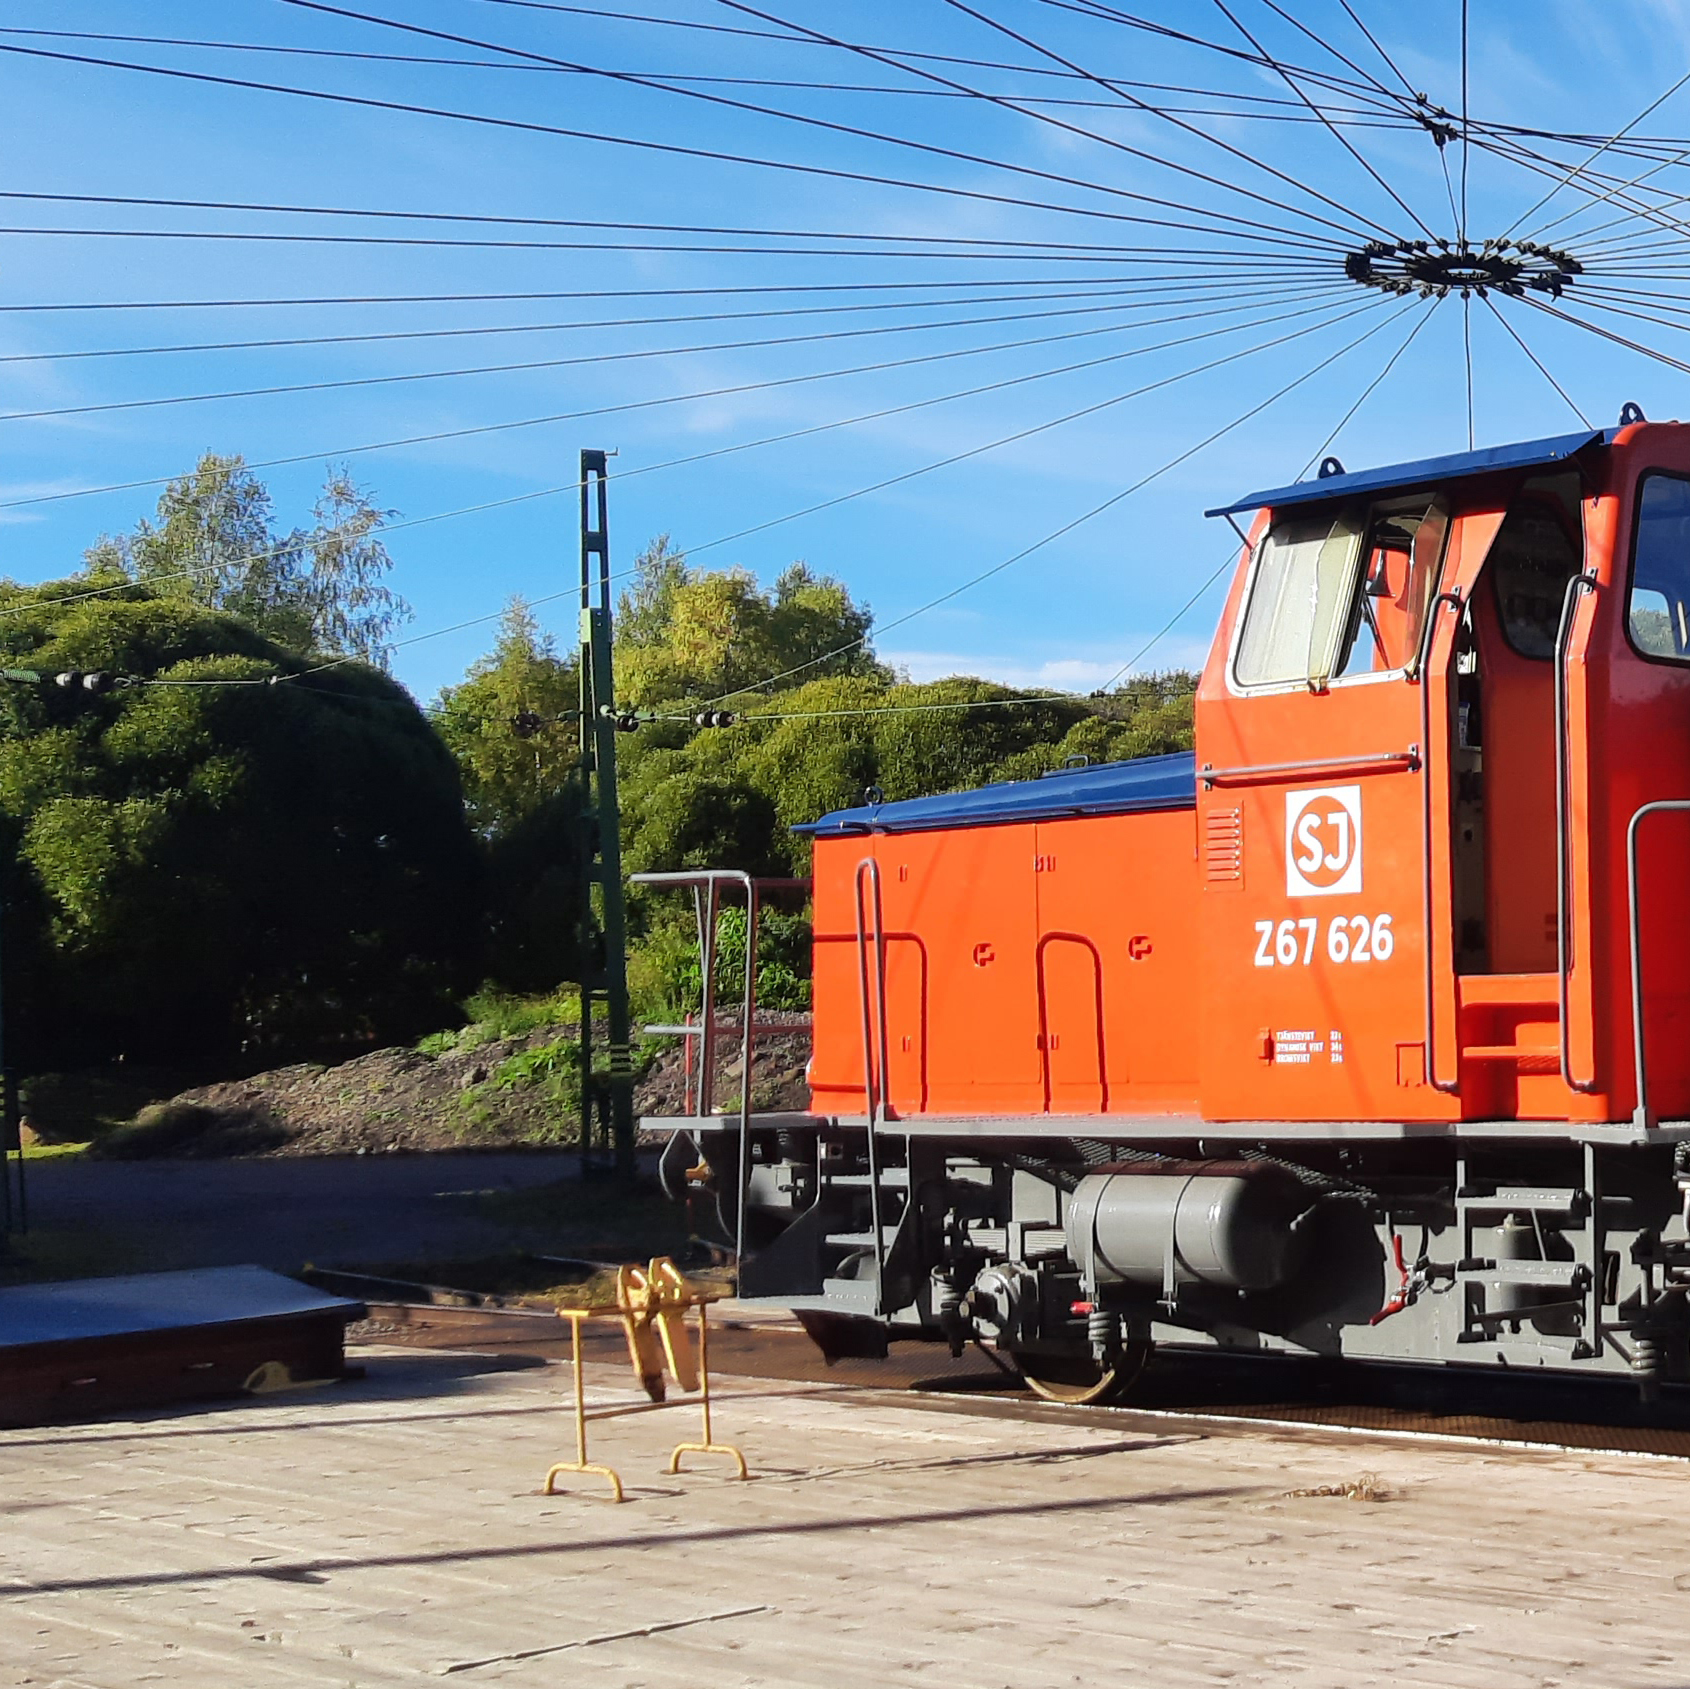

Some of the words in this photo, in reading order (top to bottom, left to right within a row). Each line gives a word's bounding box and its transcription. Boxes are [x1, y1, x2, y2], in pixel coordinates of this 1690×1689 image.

[1297, 811, 1349, 873] SJ
[1254, 917, 1318, 967] Z67
[1327, 912, 1394, 964] 626
